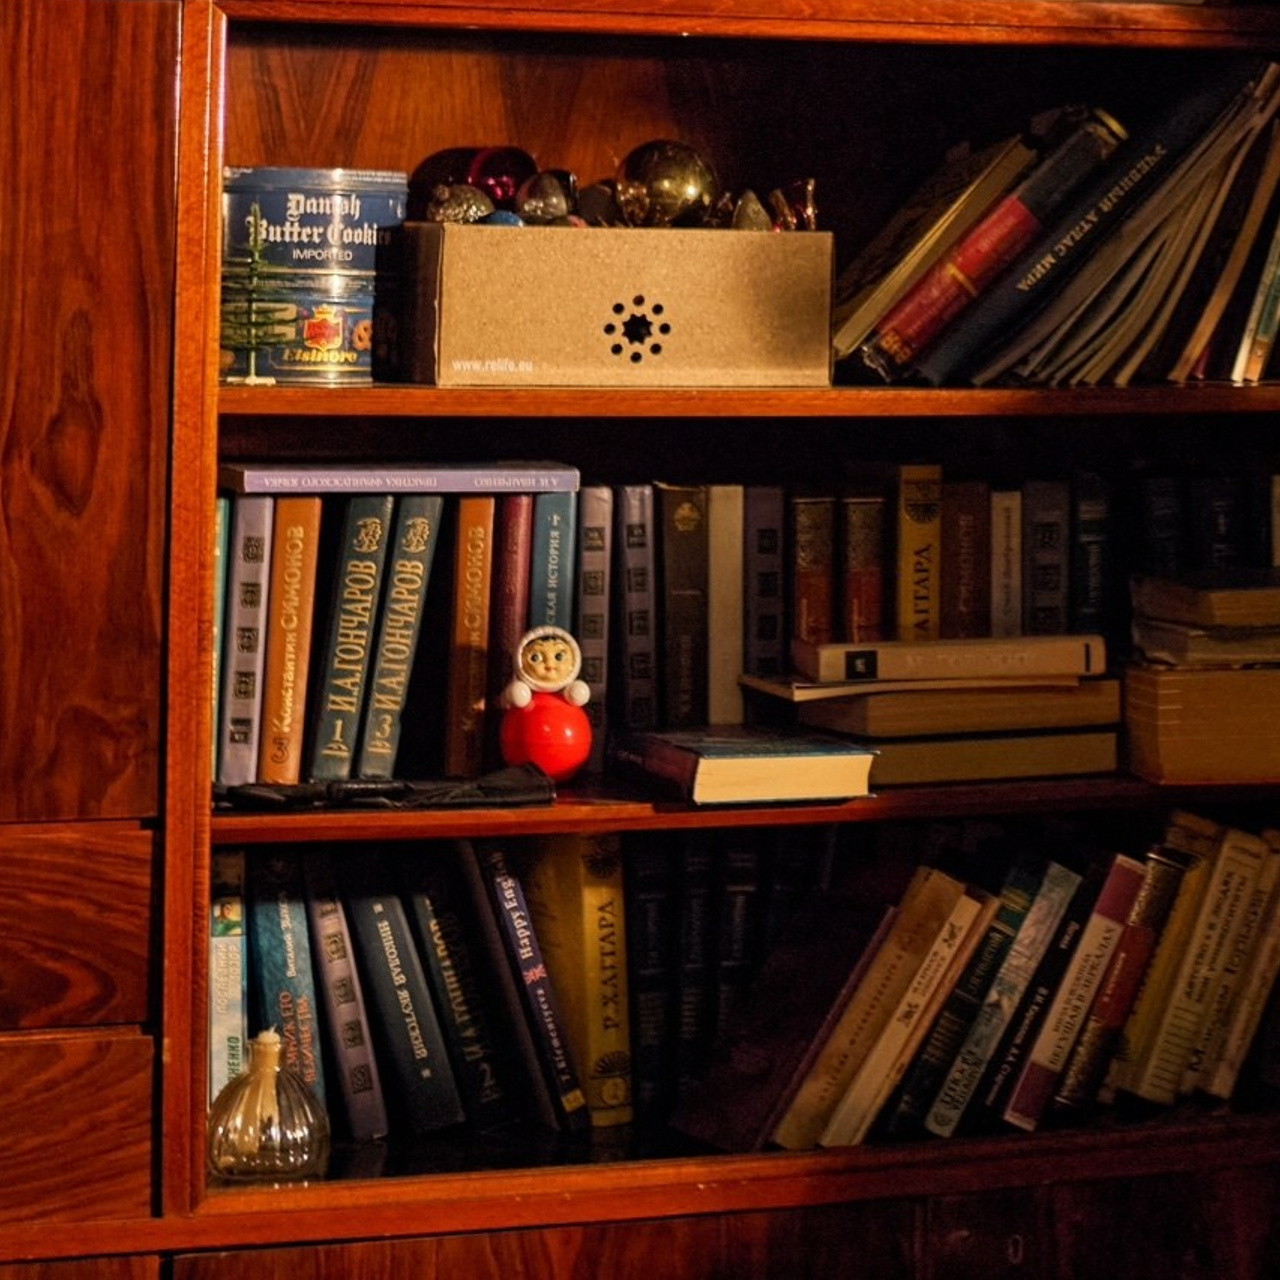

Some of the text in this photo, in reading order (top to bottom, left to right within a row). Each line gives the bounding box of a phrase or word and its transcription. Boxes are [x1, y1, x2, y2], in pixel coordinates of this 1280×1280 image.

[287, 193, 360, 221] Danish
[246, 215, 324, 245] Butter
[1052, 209, 1103, 259] АТЛАС
[293, 249, 353, 261] IMPORTED
[1015, 252, 1059, 296] МИРА
[264, 472, 300, 485] ЯЗЫКА
[302, 473, 384, 486] ФРАНЦУЗСКОГО
[385, 474, 438, 487] ПРАКТИКА
[474, 475, 536, 487] ИВАНЧЕНКО
[465, 525, 484, 629] СИМОНОВ
[546, 531, 559, 623] СКАЯ ИСТОРИЯ
[274, 527, 305, 732] Константин СИМОНОВ
[375, 713, 391, 738] 3
[270, 736, 289, 763] 3
[508, 909, 537, 960] Happy
[1079, 924, 1116, 989] ЗЕРКАЛАХ
[377, 920, 428, 1060] НИКОЛАЙ ЯКУТСКИЙ
[227, 1036, 240, 1079] НЕНКО
